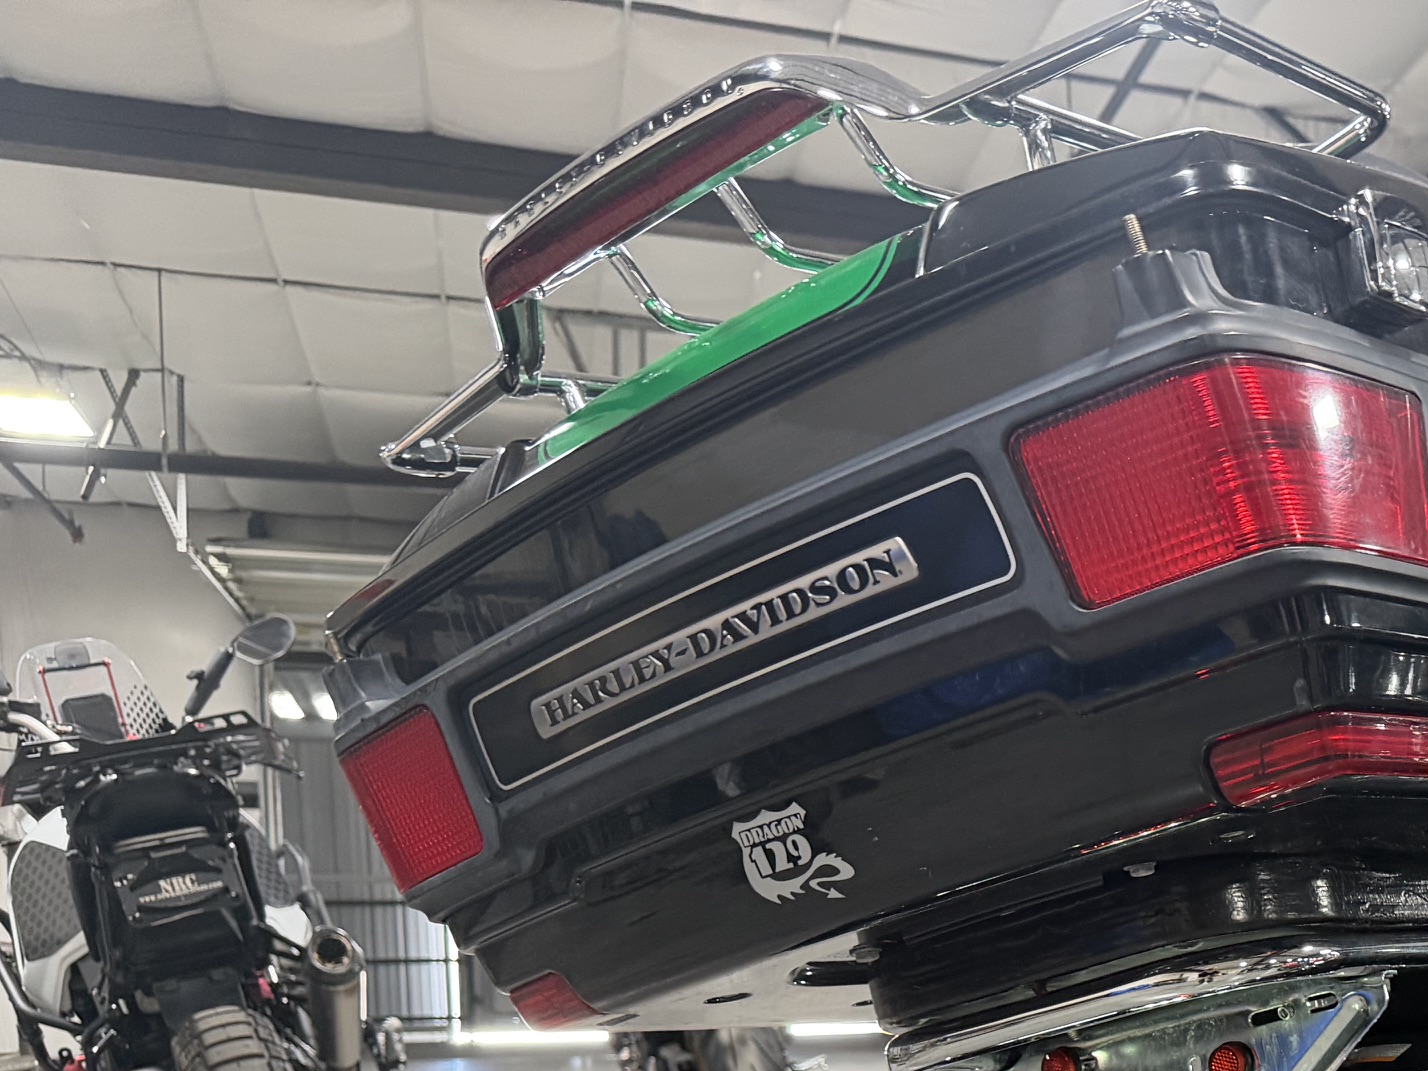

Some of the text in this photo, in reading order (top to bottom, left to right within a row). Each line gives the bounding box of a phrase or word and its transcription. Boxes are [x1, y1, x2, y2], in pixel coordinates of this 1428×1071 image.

[541, 548, 900, 726] HARLEY-DAVIDSON
[740, 814, 805, 848] DRAGON
[750, 833, 812, 878] 129
